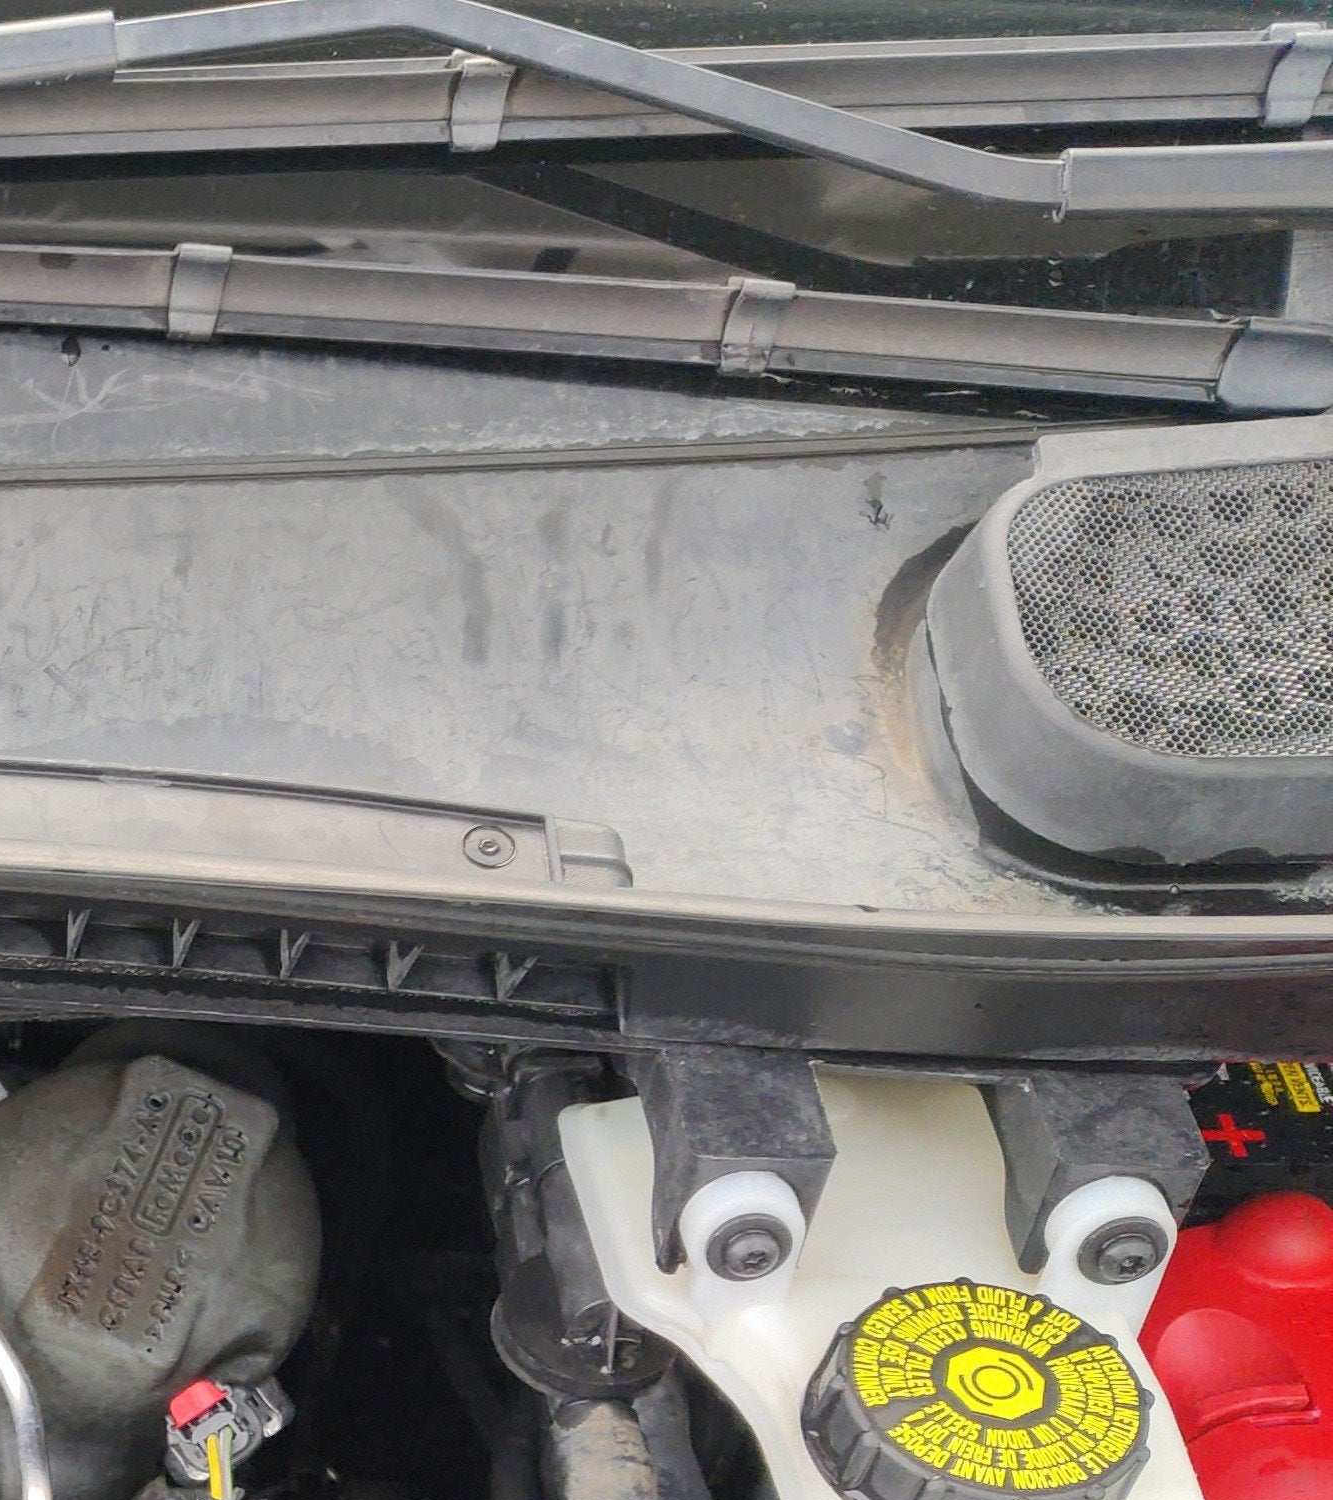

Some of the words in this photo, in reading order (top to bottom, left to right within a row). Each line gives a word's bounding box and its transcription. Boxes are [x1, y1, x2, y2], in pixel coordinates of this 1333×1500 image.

[904, 1292, 925, 1309] A
[922, 1285, 972, 1306] FROM
[976, 1286, 1028, 1311] FLUID
[1029, 1300, 1044, 1315] 4
[861, 1299, 913, 1339] SEALED
[891, 1303, 964, 1342] REMOVING
[965, 1302, 1030, 1329] BEFORE
[1043, 1308, 1082, 1333] DOT
[914, 1321, 968, 1355] CLEAN
[969, 1320, 1052, 1358] WARNING
[1031, 1322, 1068, 1345] CAP
[879, 1339, 910, 1366] USE
[853, 1337, 889, 1407] CONTAINER
[879, 1367, 911, 1398] ONLY
[906, 1351, 937, 1397] FILLER
[1087, 1344, 1140, 1406] ATTENTION
[1045, 1356, 1086, 1424] PROVENANT
[914, 1420, 951, 1445] DOT
[923, 1400, 982, 1441] SCELLE
[1078, 1414, 1110, 1440] QUE
[887, 1422, 951, 1469] DEPOSE
[985, 1428, 1034, 1449] BIDON
[1067, 1431, 1096, 1453] DU
[1094, 1407, 1140, 1463] NETTOYER
[945, 1436, 993, 1466] FREIN
[997, 1448, 1018, 1469] DE
[1019, 1441, 1078, 1469] LIQUIDE
[1078, 1452, 1110, 1475] LE
[947, 1459, 1006, 1487] AVANT
[1011, 1461, 1089, 1490] BOUCHON
